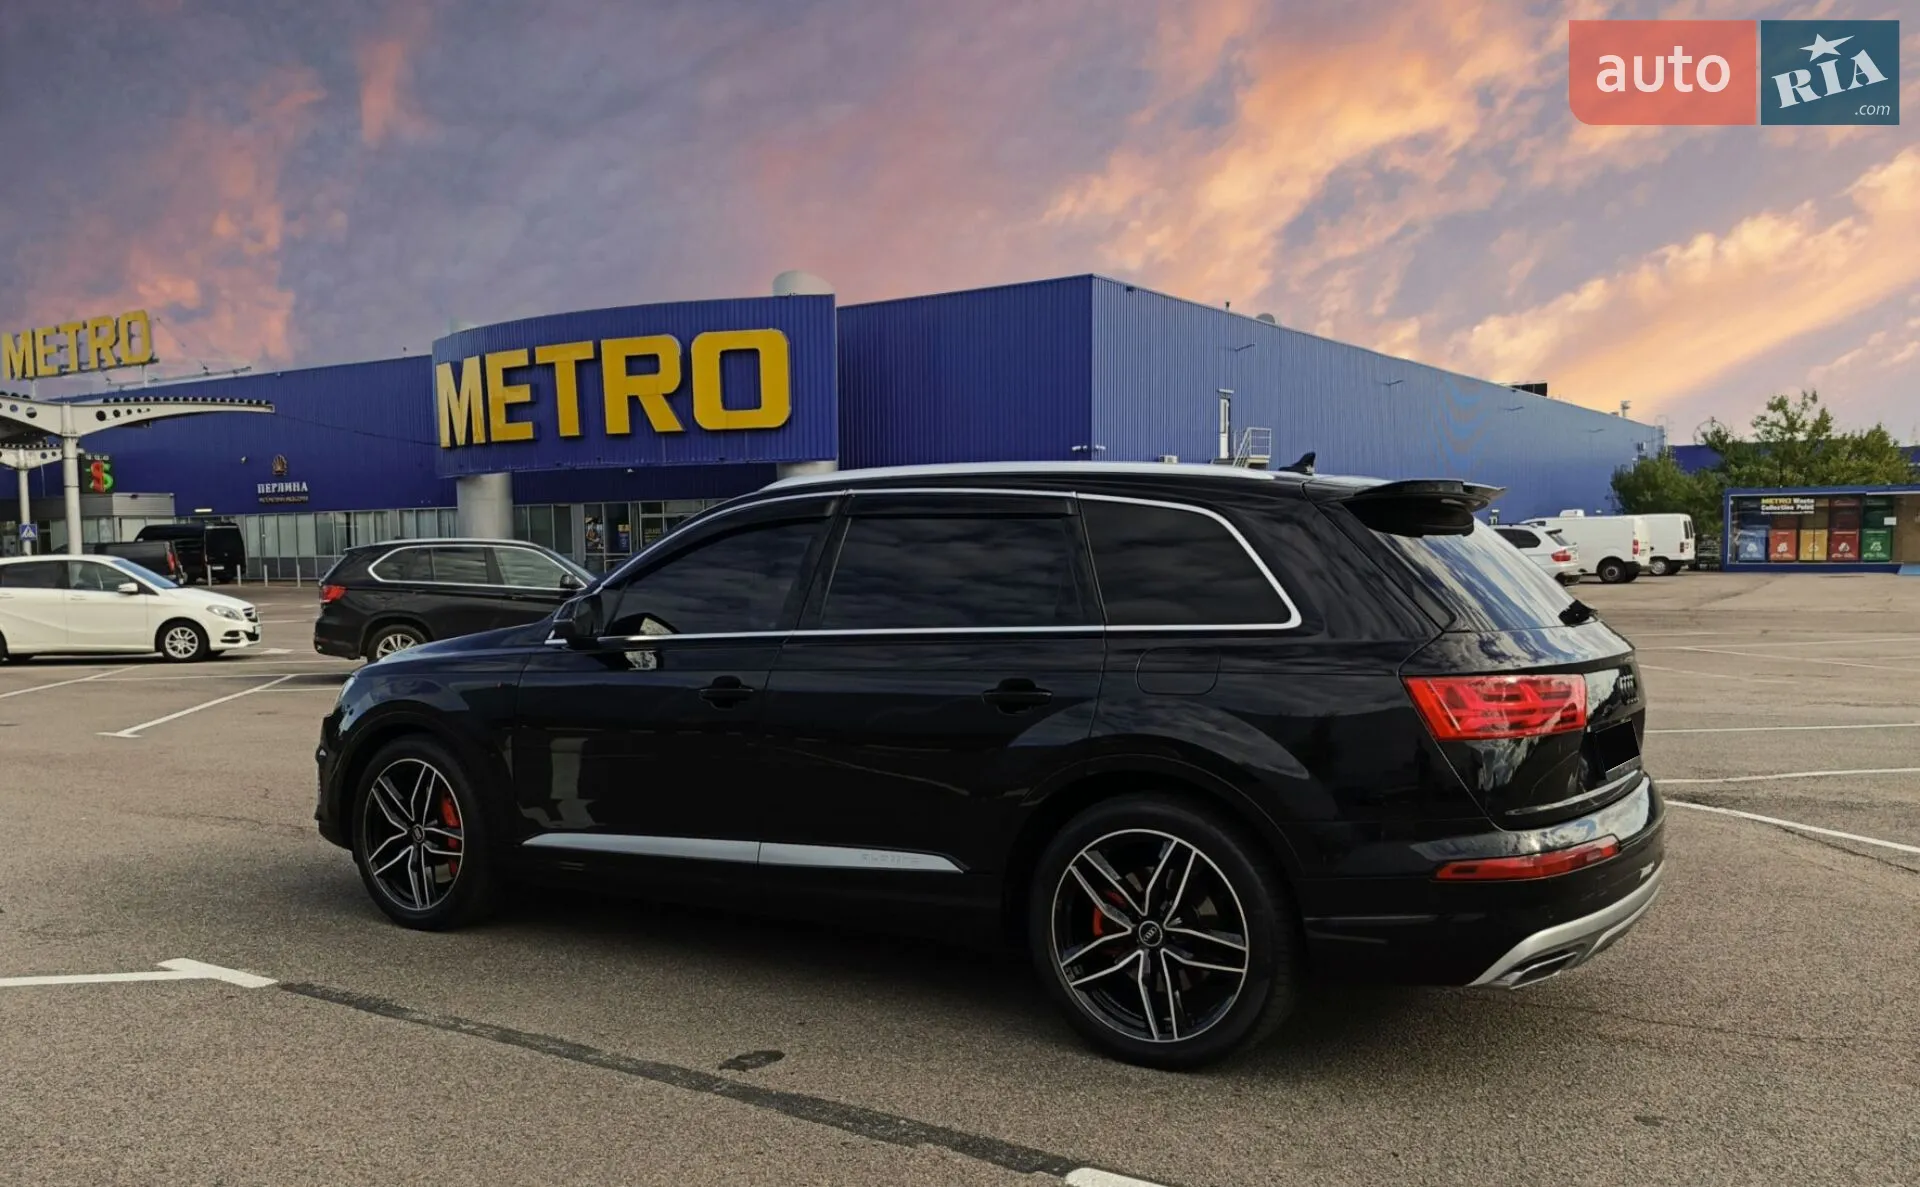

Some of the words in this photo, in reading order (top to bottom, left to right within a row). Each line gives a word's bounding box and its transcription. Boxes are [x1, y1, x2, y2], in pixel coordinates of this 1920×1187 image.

[1, 309, 153, 382] METRO
[436, 328, 792, 449] METRO
[257, 481, 309, 495] ПЕРЛИНА
